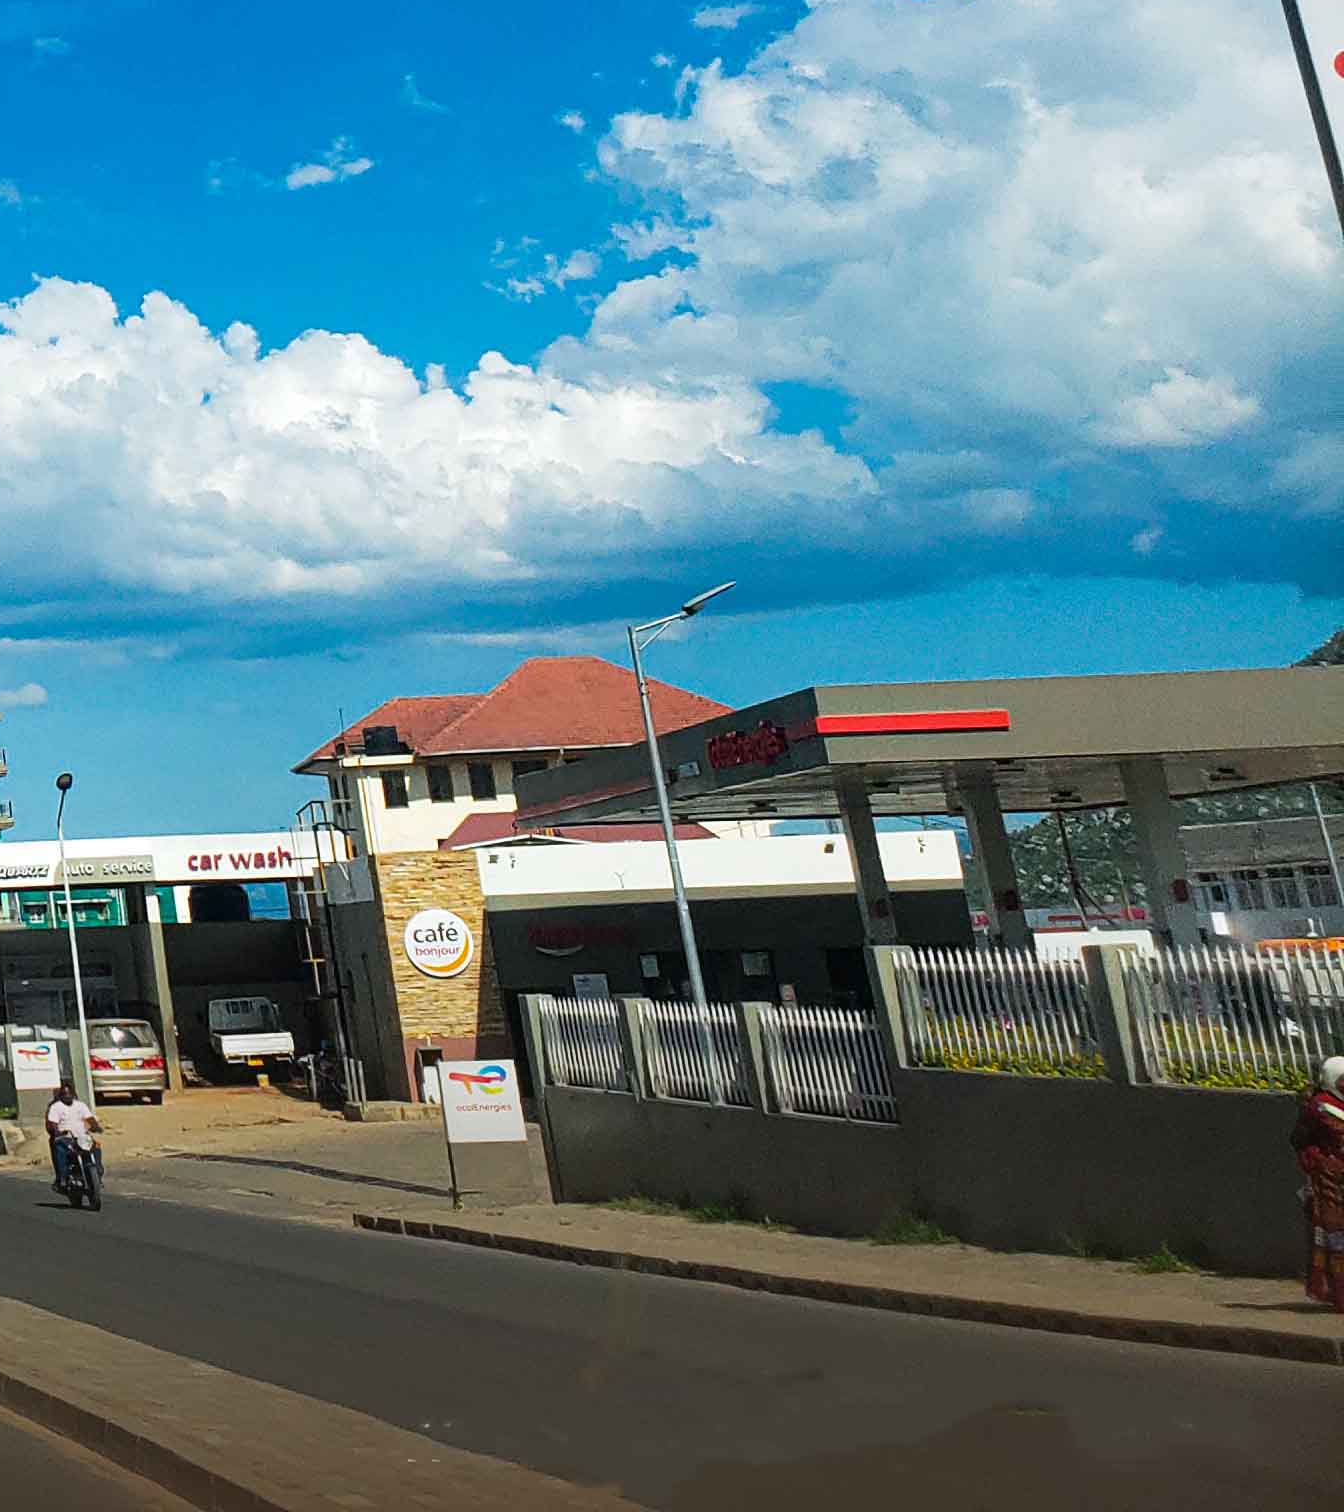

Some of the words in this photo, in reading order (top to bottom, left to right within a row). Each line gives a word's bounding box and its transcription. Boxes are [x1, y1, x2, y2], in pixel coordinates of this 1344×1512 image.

[62, 861, 95, 877] uto
[103, 857, 153, 876] service
[188, 853, 222, 871] car
[229, 845, 292, 870] wash
[413, 921, 458, 943] café
[415, 945, 460, 958] bonjour
